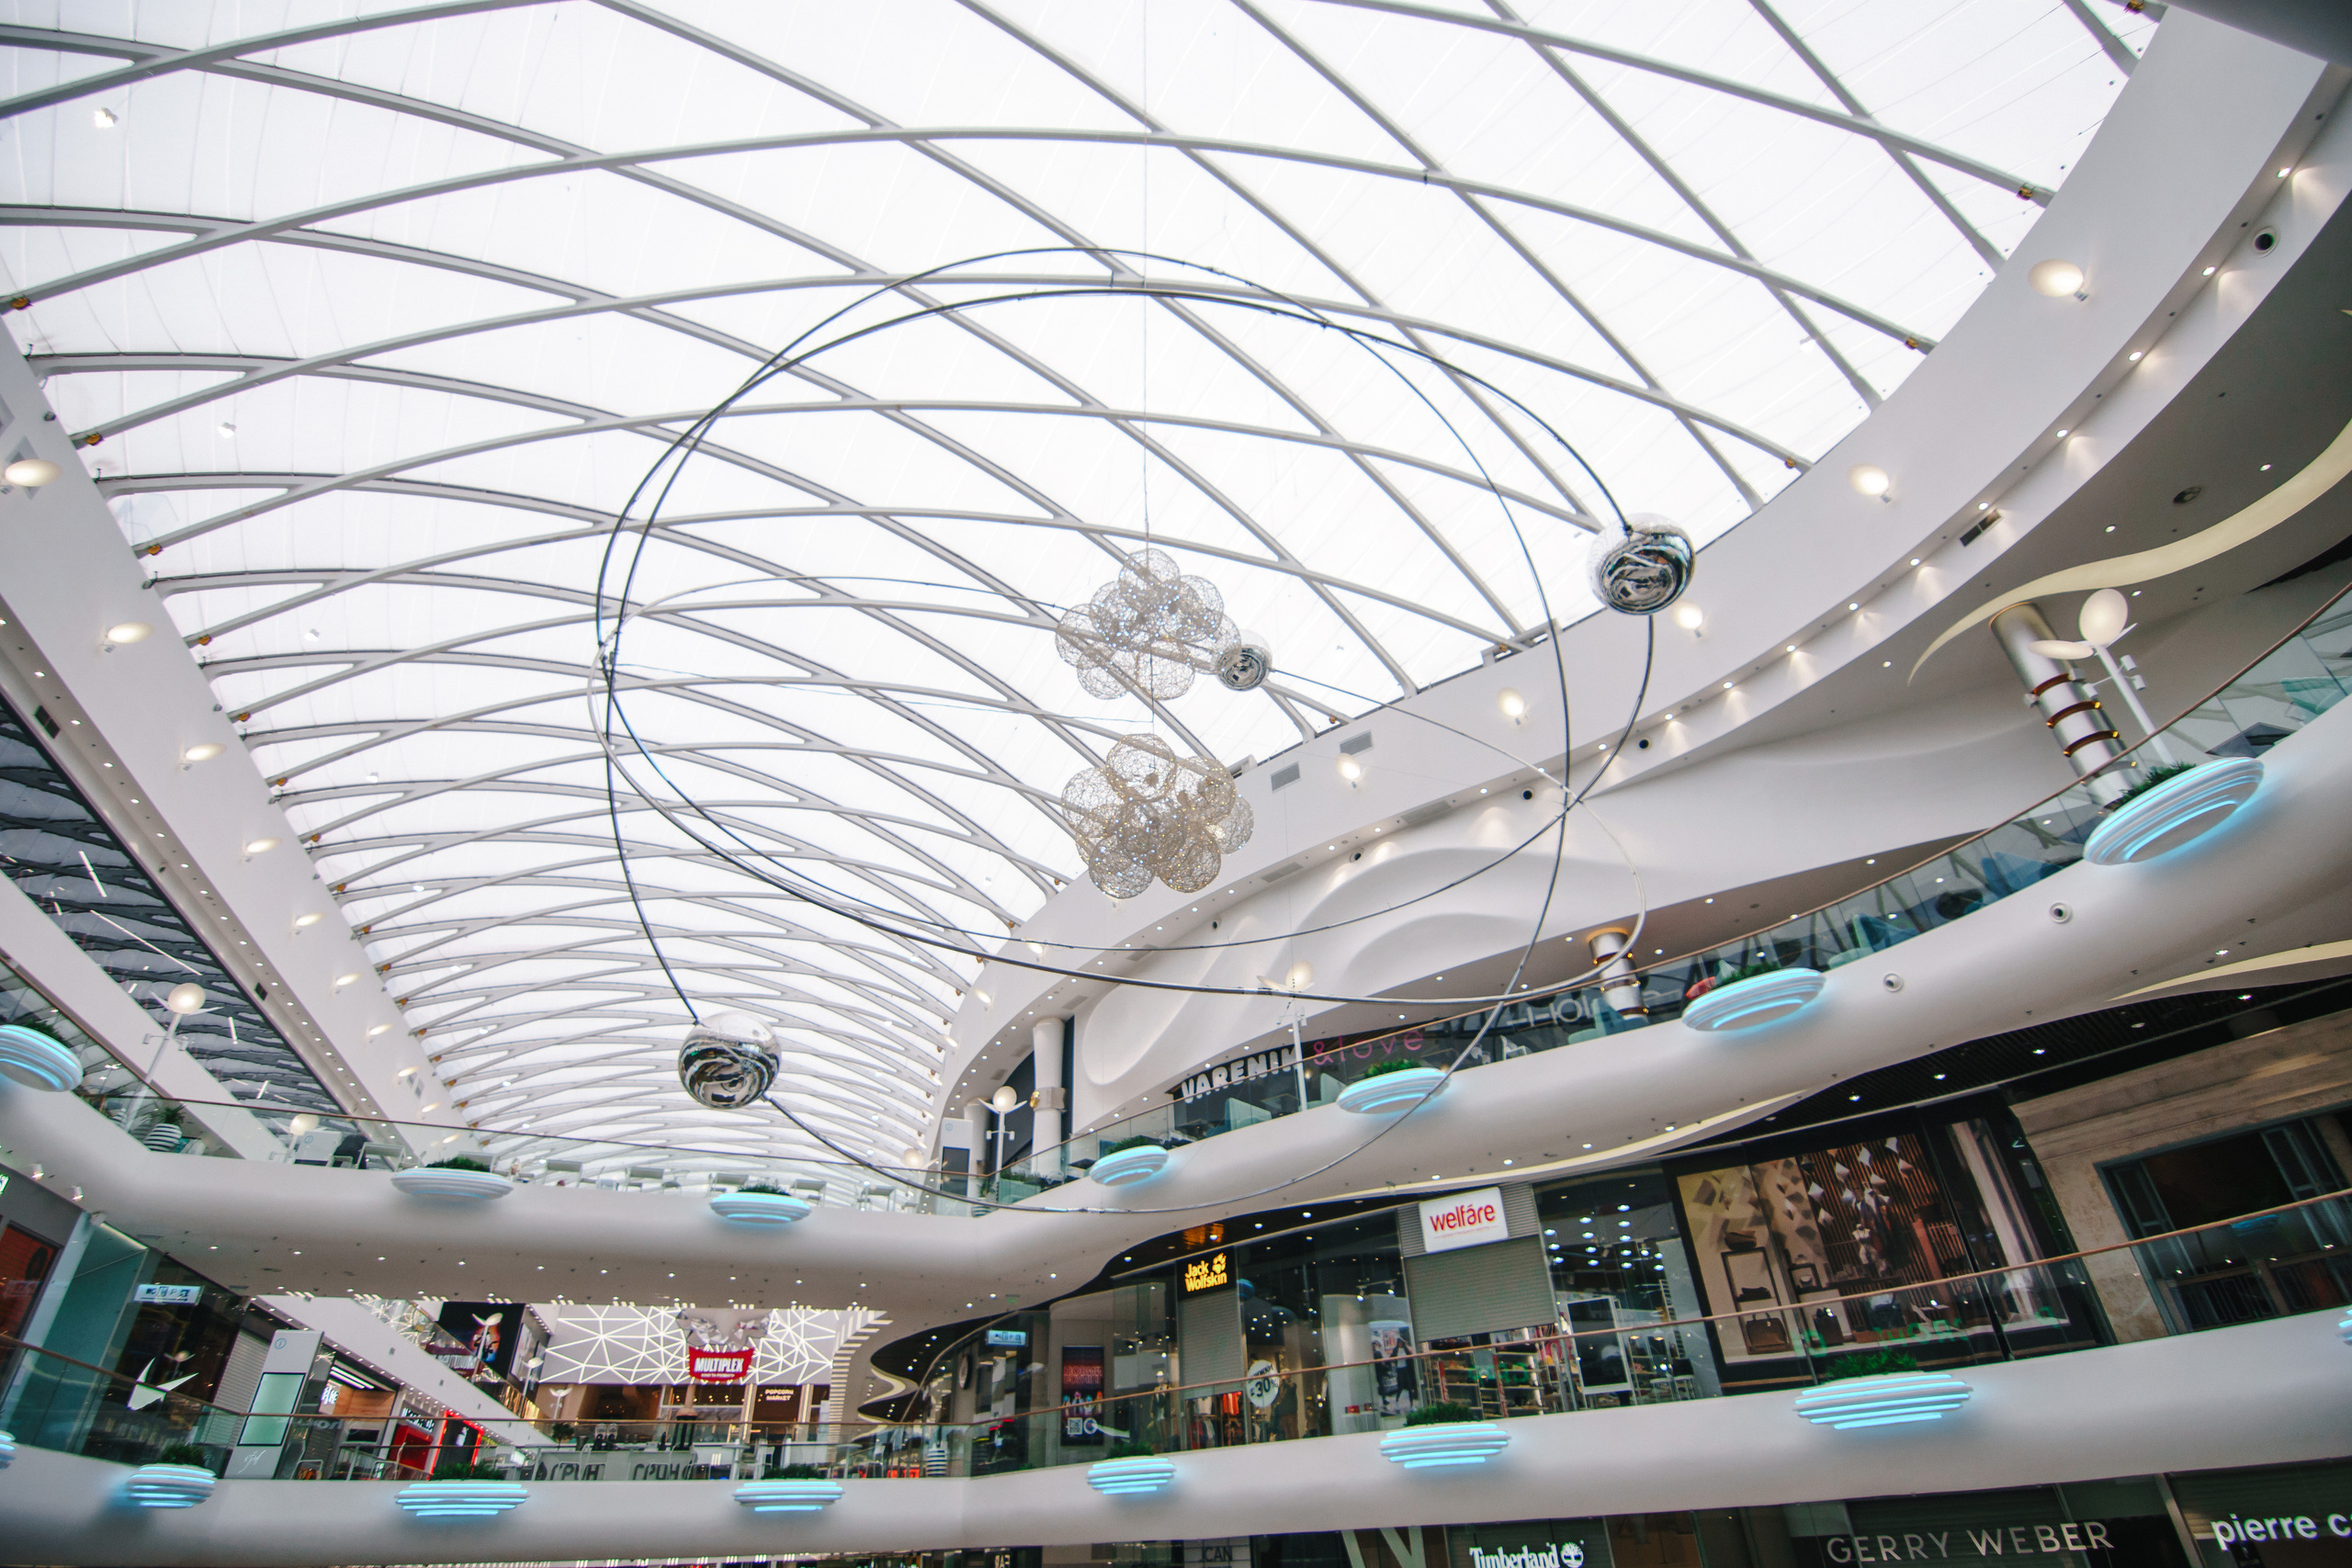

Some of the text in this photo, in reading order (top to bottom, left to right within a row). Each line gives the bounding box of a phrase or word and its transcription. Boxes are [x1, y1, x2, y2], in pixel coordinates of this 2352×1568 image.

[1184, 1260, 1209, 1279] Jack
[1184, 1271, 1227, 1292] Wolfskin
[693, 1357, 745, 1373] MULTIPLEX
[1826, 1521, 2115, 1563] GERRY WEBER
[2211, 1513, 2352, 1551] pierre c
[1469, 1543, 1561, 1568] Timberland
